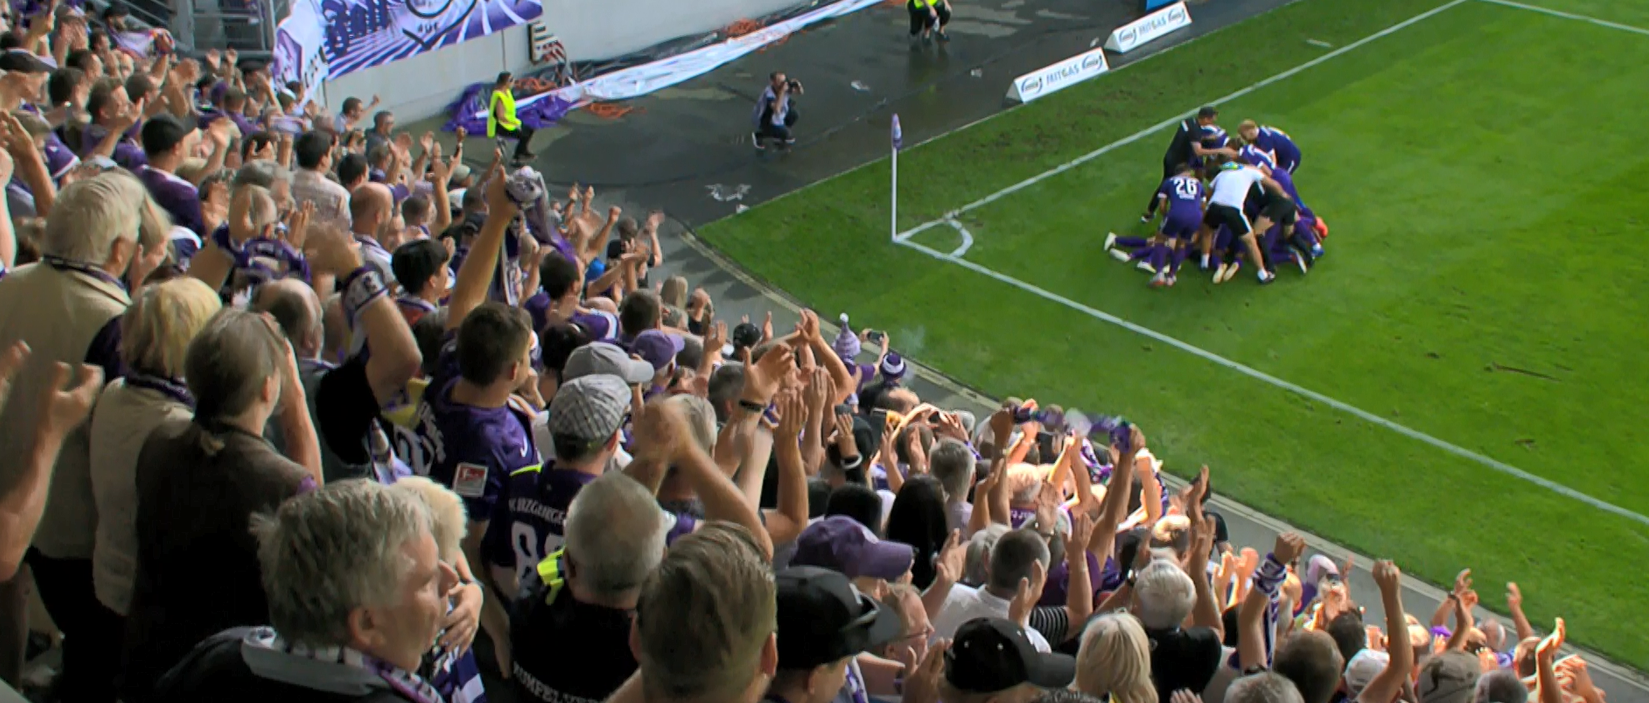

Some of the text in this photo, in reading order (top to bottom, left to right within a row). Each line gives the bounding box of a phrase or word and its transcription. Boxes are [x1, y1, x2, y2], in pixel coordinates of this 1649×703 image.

[1138, 16, 1167, 36] MITGAS
[1046, 63, 1080, 86] MITGAS
[1174, 177, 1197, 195] 26
